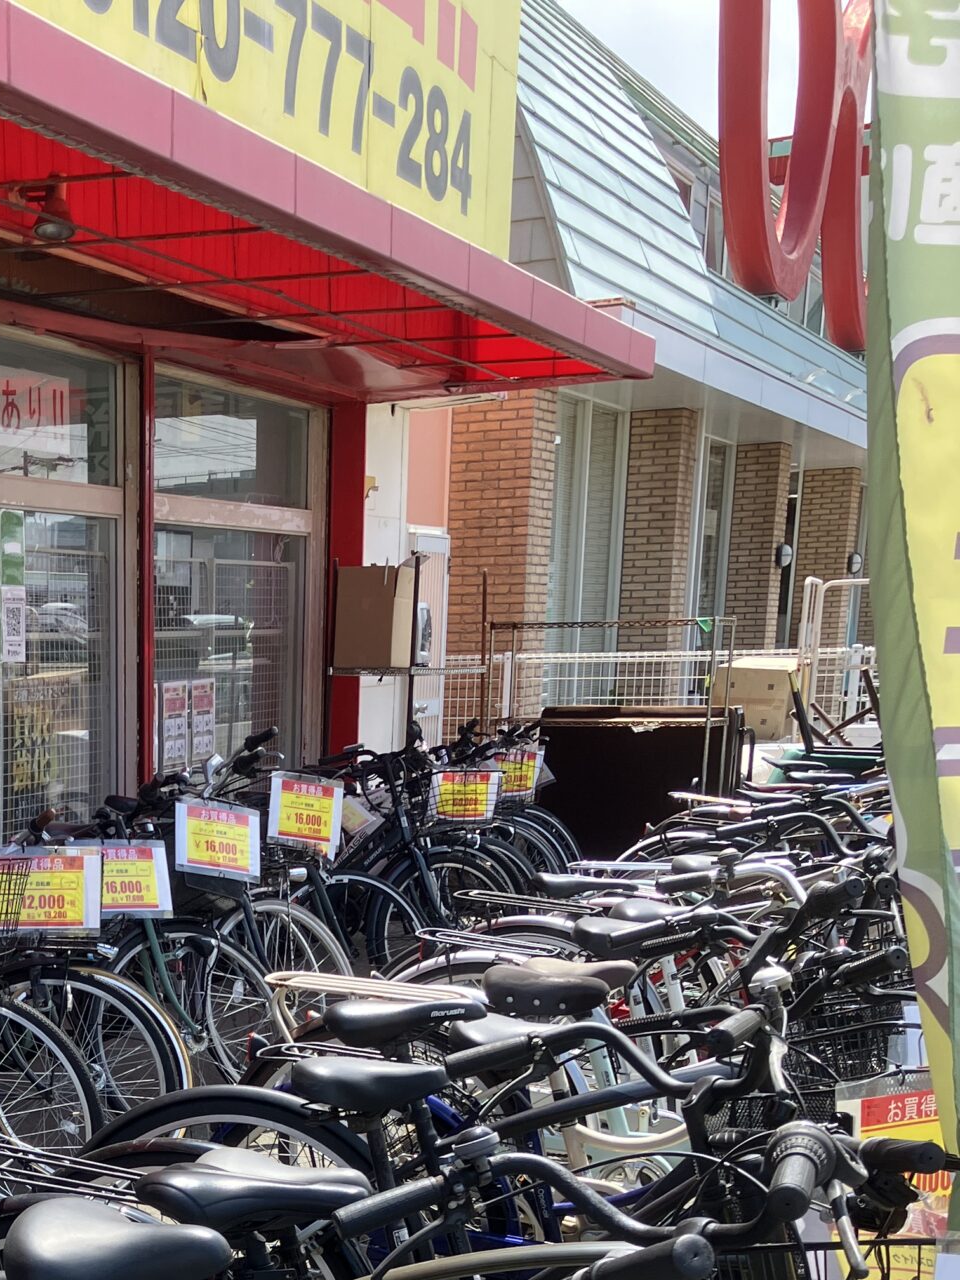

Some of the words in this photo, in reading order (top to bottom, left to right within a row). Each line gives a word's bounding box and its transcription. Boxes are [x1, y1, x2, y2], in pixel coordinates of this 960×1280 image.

[295, 813, 322, 827] 16,000
[205, 840, 237, 856] 16,000
[104, 880, 142, 894] 16,000
[431, 1008, 465, 1018] marushi
[887, 1094, 937, 1122] お買得
